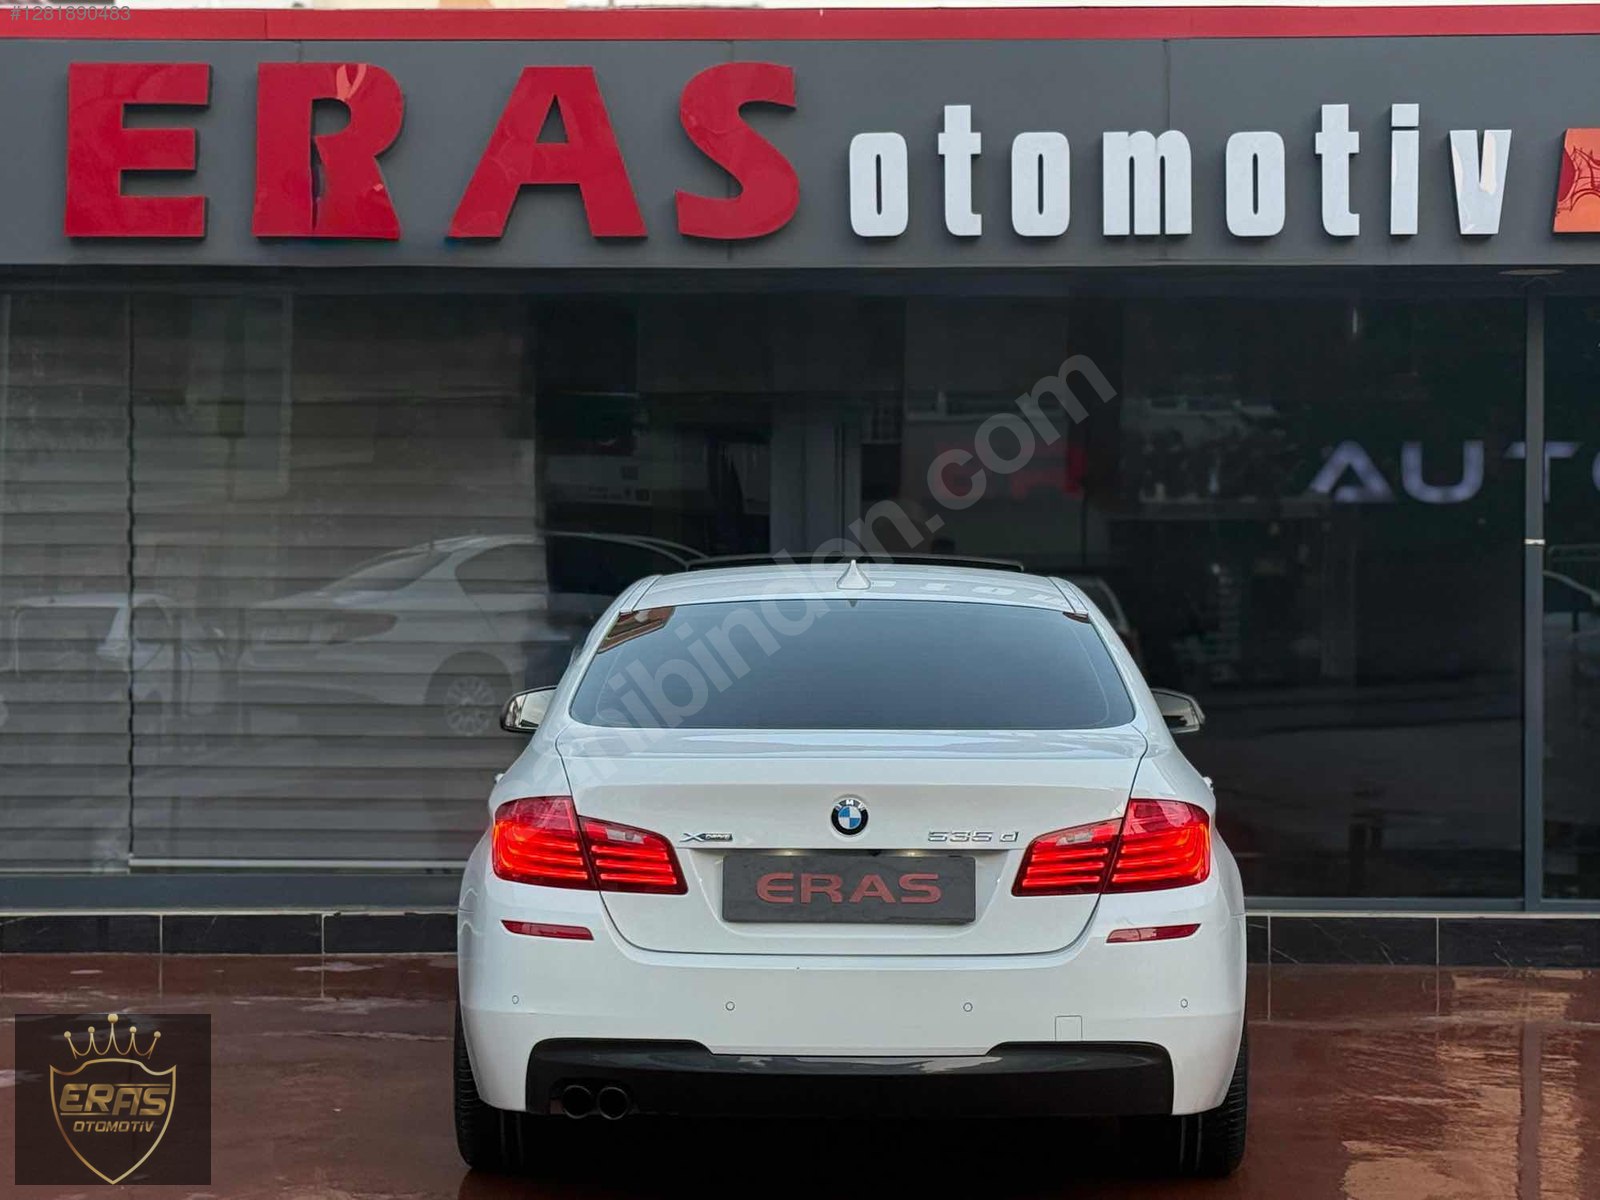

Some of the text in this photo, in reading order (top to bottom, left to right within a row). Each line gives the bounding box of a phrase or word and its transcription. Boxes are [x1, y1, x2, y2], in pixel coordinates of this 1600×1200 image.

[65, 62, 1512, 240] ERAS otomotiv
[756, 873, 943, 904] ERAS
